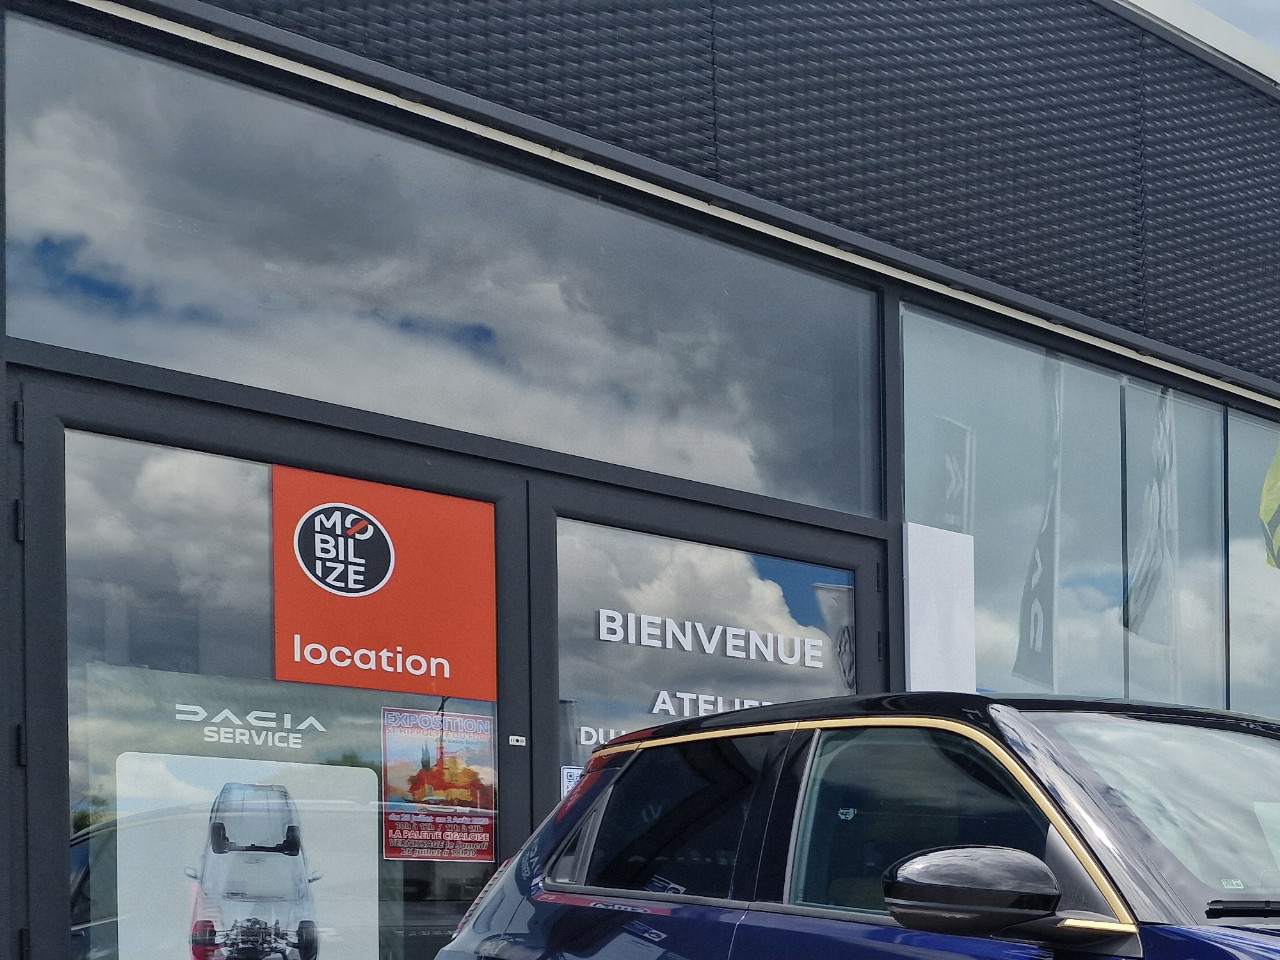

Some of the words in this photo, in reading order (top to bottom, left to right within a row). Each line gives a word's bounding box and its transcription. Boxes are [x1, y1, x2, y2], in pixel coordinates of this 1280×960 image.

[599, 608, 824, 668] BIENVENUE
[294, 634, 450, 678] location
[175, 703, 327, 732] DACIA
[385, 712, 490, 734] EXPOSITION
[203, 726, 302, 749] SERVICE
[388, 830, 403, 839] LA
[403, 830, 442, 840] PALETTE
[443, 832, 490, 841] CIGALOISE
